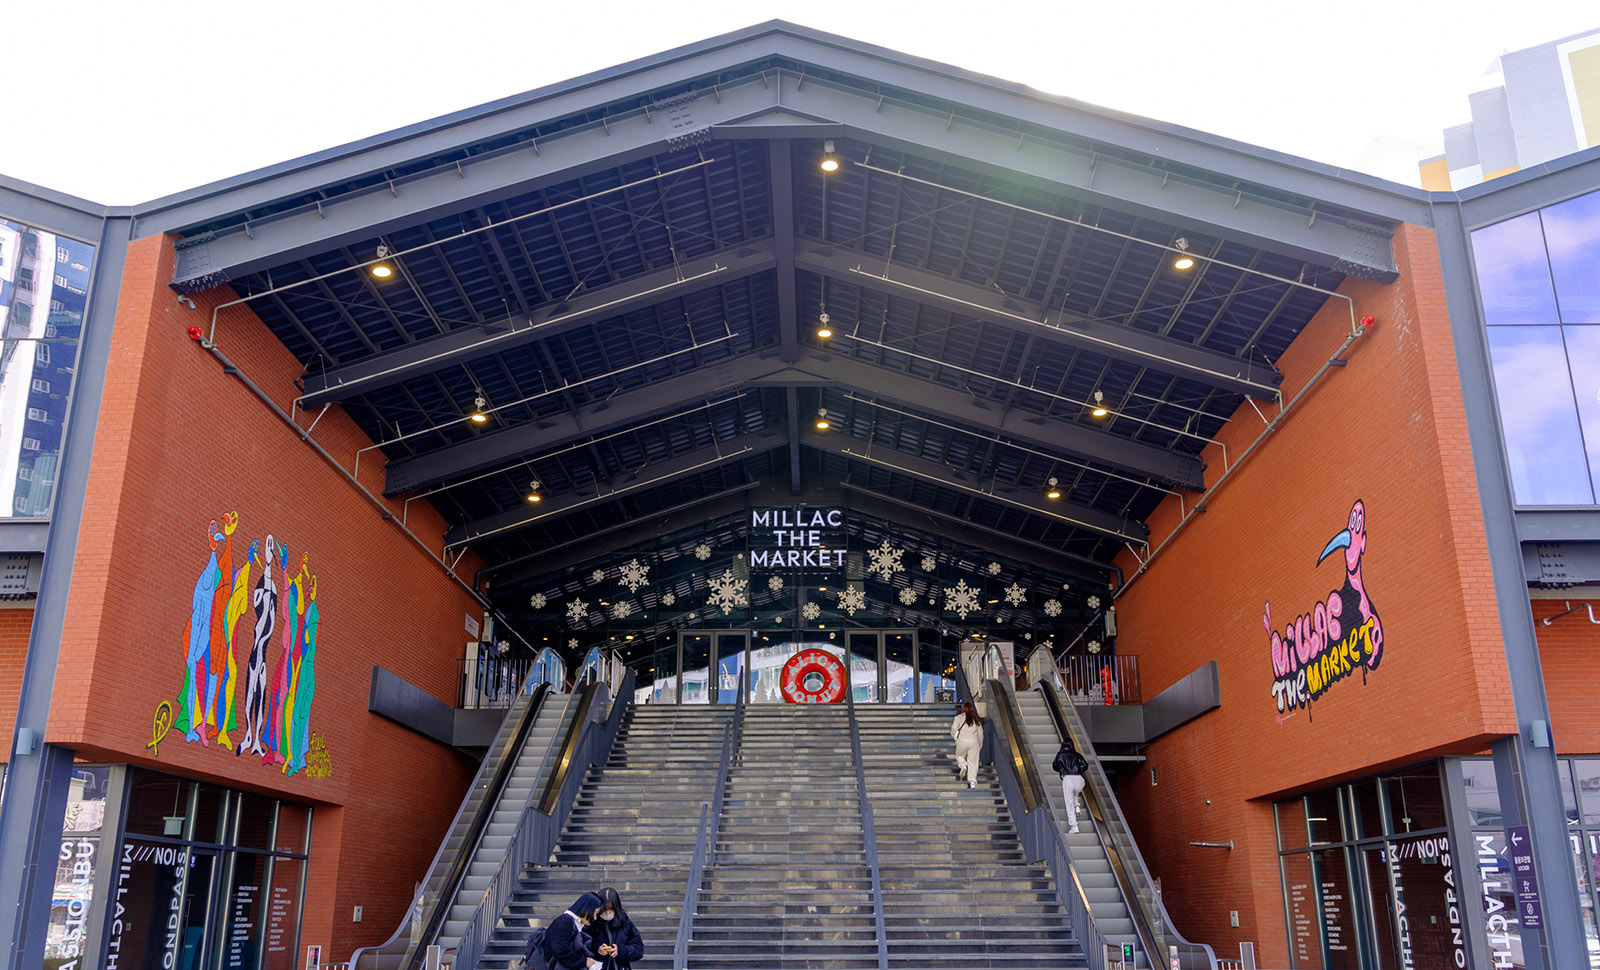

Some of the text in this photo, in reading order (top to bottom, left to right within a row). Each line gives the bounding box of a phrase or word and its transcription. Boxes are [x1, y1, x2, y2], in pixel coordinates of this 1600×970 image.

[752, 510, 842, 527] MILLAC
[773, 530, 821, 547] THE
[751, 550, 847, 567] MARKET
[788, 653, 839, 676] ALICE
[784, 680, 840, 703] DONUT
